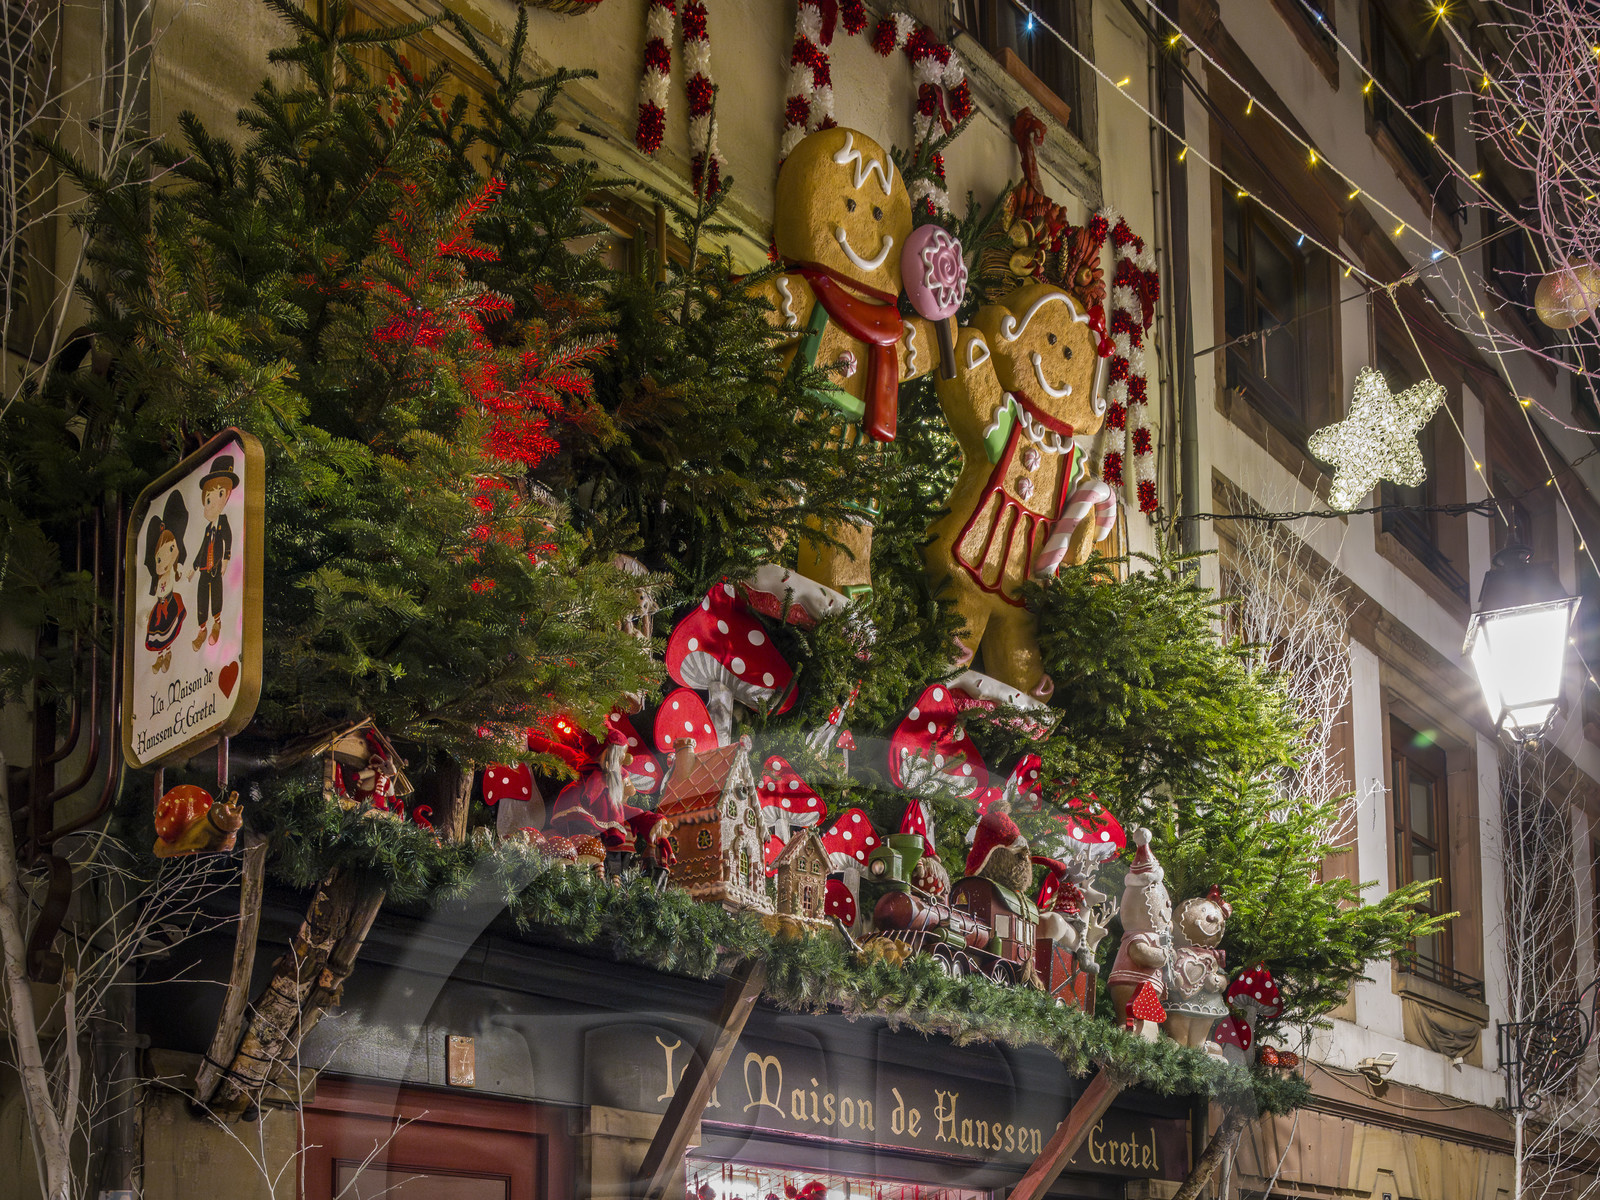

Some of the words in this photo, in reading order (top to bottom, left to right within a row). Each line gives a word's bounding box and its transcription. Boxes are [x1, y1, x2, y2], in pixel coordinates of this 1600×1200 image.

[150, 691, 164, 720] La
[167, 677, 202, 711] Maison
[203, 668, 213, 686] de
[137, 726, 173, 756] Hanssen
[173, 707, 187, 735] &
[186, 693, 216, 728] Gretel
[454, 1044, 470, 1072] 7
[743, 1051, 875, 1132] Maison
[890, 1087, 922, 1138] de
[933, 1088, 1043, 1155] Hanssen
[1088, 1119, 1160, 1171] Gretel
